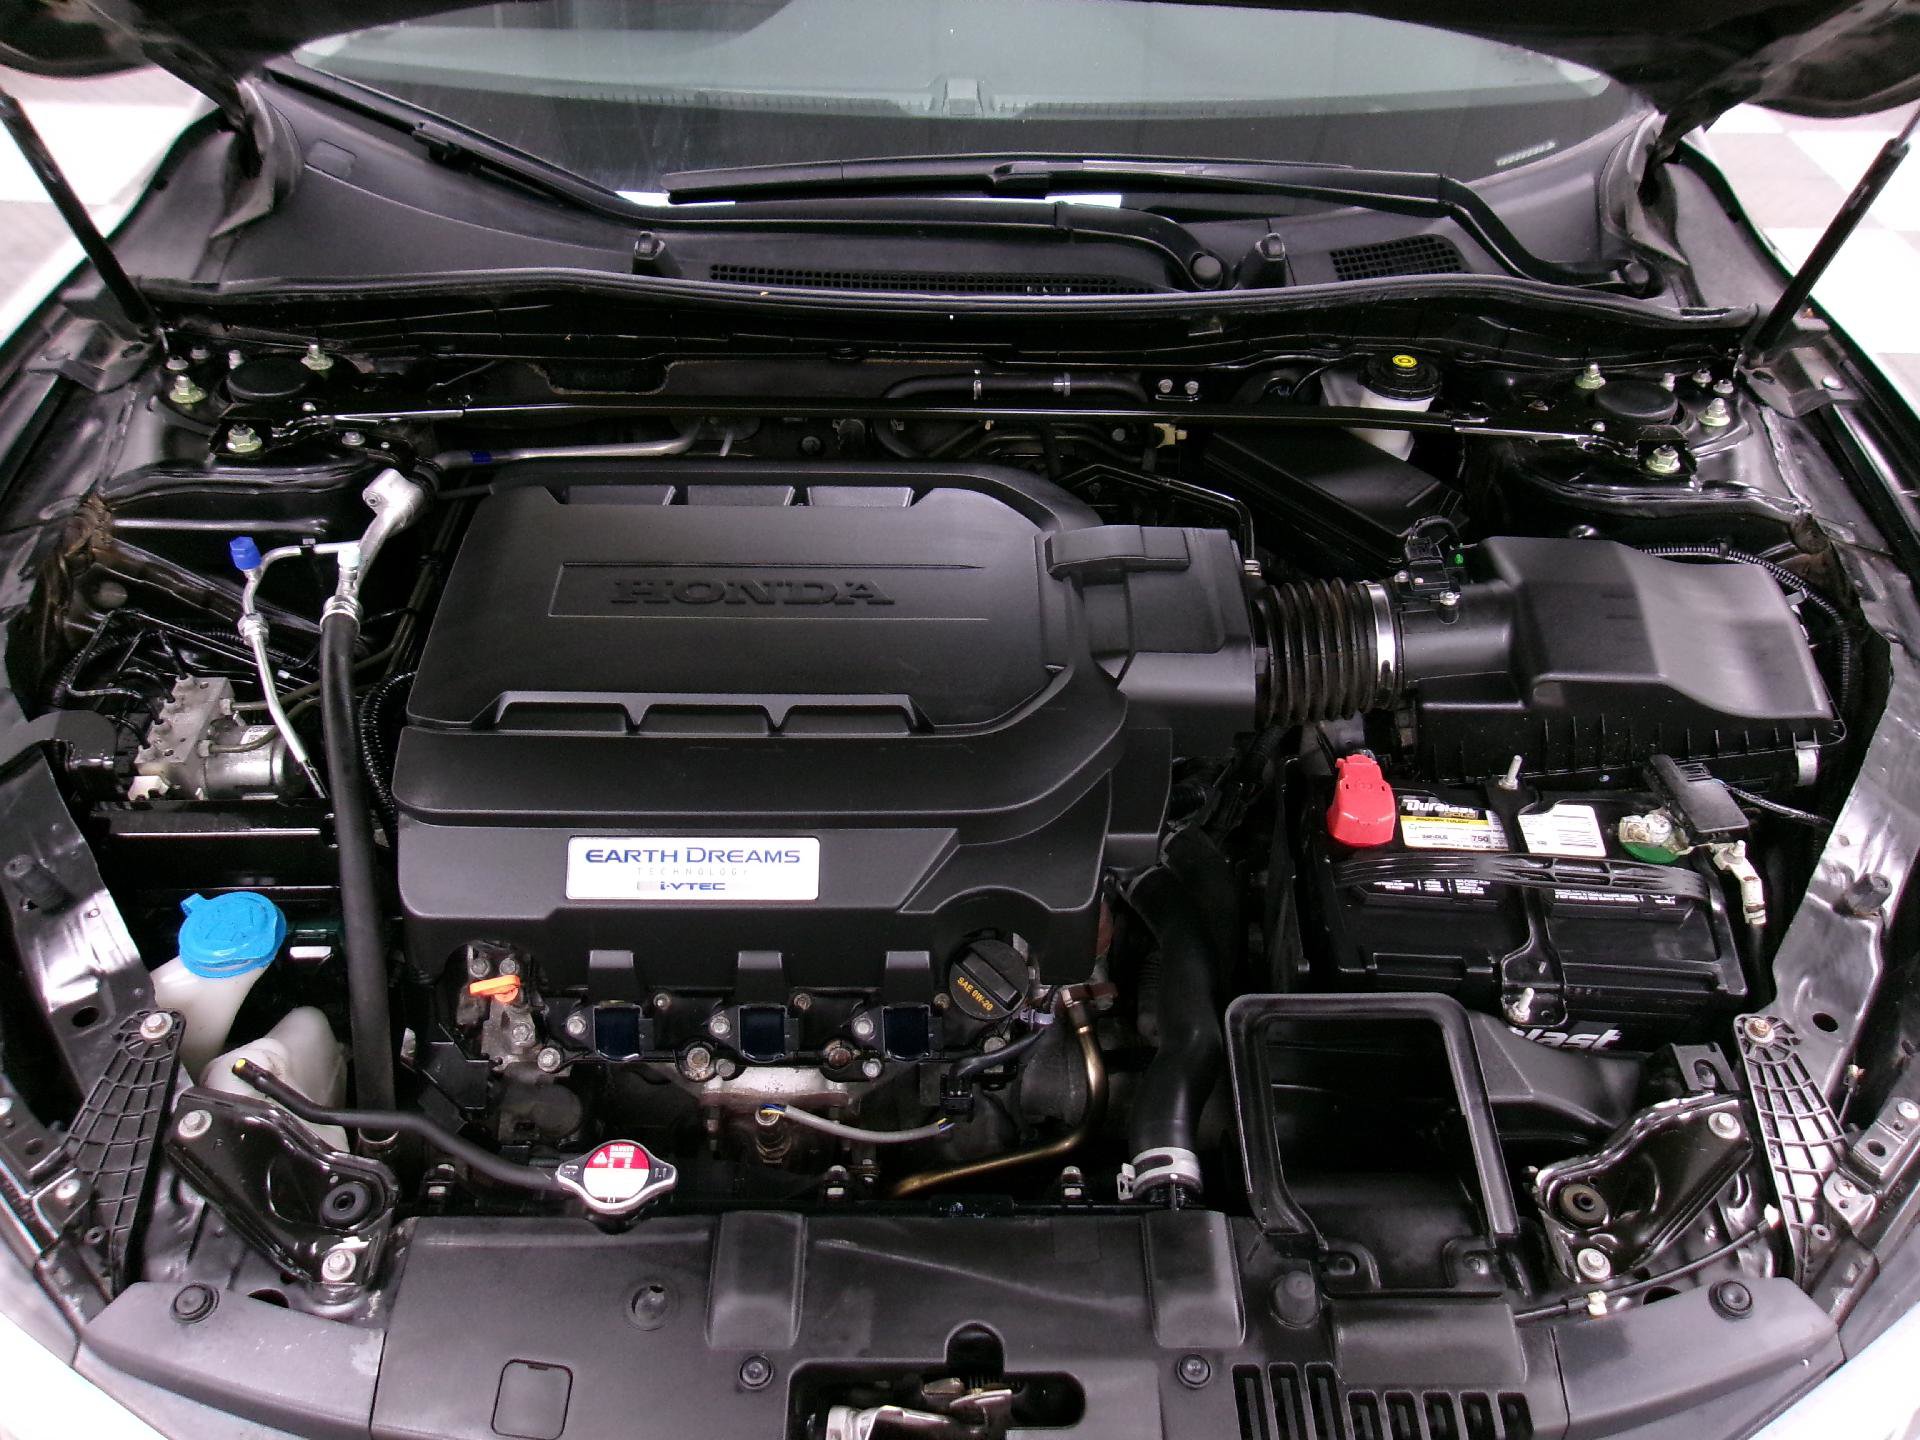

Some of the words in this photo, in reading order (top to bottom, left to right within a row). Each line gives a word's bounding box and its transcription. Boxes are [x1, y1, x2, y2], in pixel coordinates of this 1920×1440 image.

[611, 579, 895, 605] HONDA
[1471, 835, 1489, 843] 750
[585, 849, 678, 864] EARTH
[686, 847, 801, 864] DREAMS
[957, 976, 974, 993] SAE
[971, 989, 994, 1011] 0W-20
